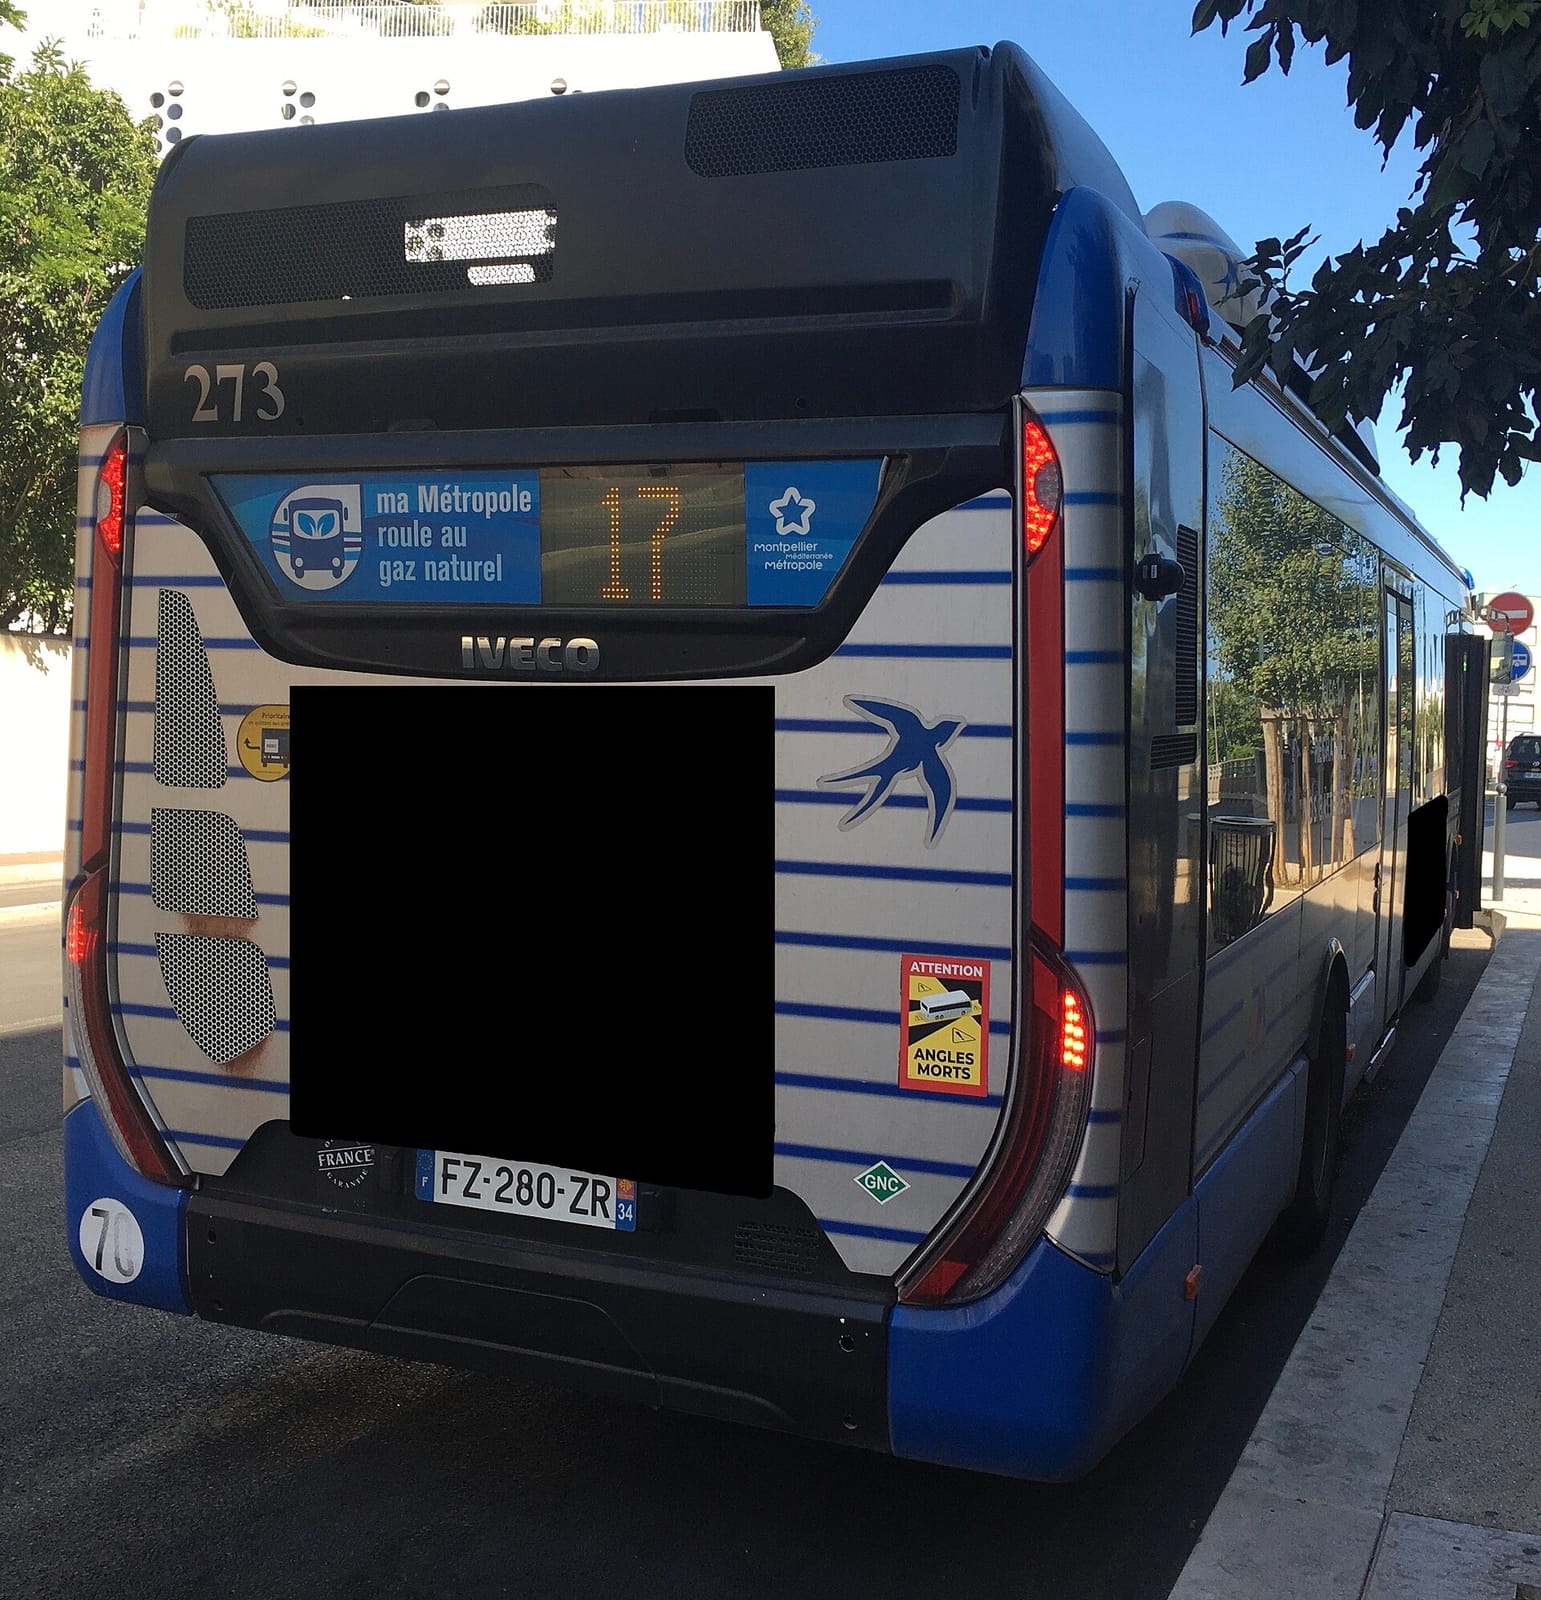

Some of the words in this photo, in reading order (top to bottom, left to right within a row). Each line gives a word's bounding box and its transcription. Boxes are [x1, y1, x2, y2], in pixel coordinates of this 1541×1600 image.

[184, 361, 285, 422] 273
[377, 492, 409, 514] ma
[418, 484, 532, 519] Métropole
[378, 520, 432, 547] roule
[441, 526, 467, 547] au
[601, 486, 680, 600] 17
[379, 560, 416, 587] gaz
[425, 553, 502, 581] naturel
[461, 636, 600, 671] IVECO
[910, 961, 983, 977] ATTENTION
[914, 1048, 974, 1065] ANGLES
[917, 1063, 971, 1080] MORTS
[318, 1149, 373, 1167] FRANCE
[422, 1176, 429, 1187] F
[441, 1157, 610, 1219] FZ-280-ZR
[864, 1174, 899, 1192] GNC
[617, 1203, 634, 1222] 34
